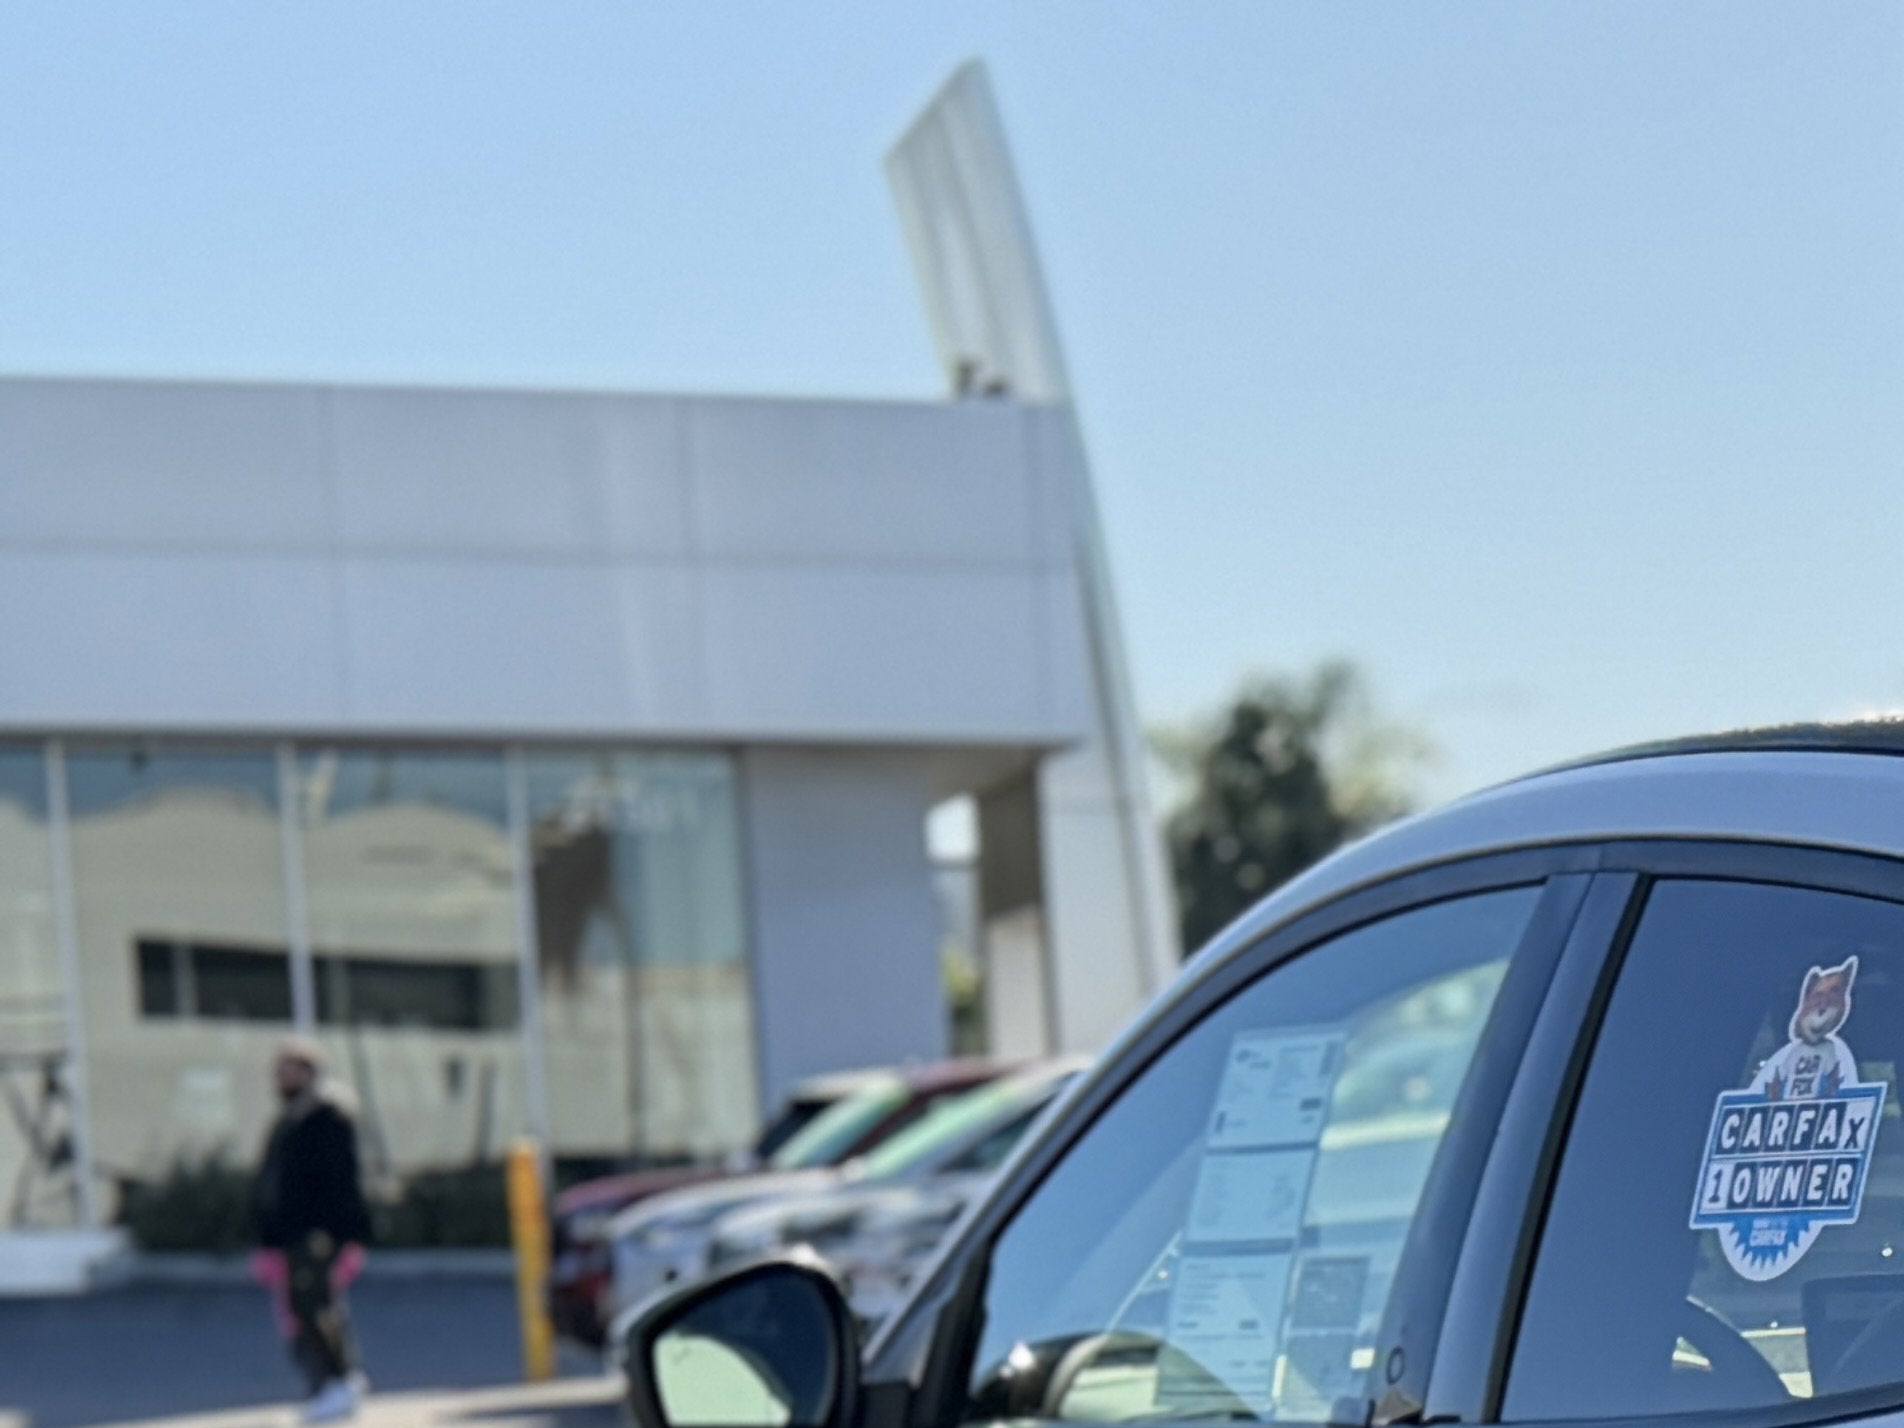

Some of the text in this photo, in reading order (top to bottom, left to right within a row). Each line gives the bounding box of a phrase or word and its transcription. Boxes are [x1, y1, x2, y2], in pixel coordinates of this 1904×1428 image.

[1720, 1107, 1865, 1150] CARFAX
[1708, 1163, 1854, 1204] 1 OWNER
